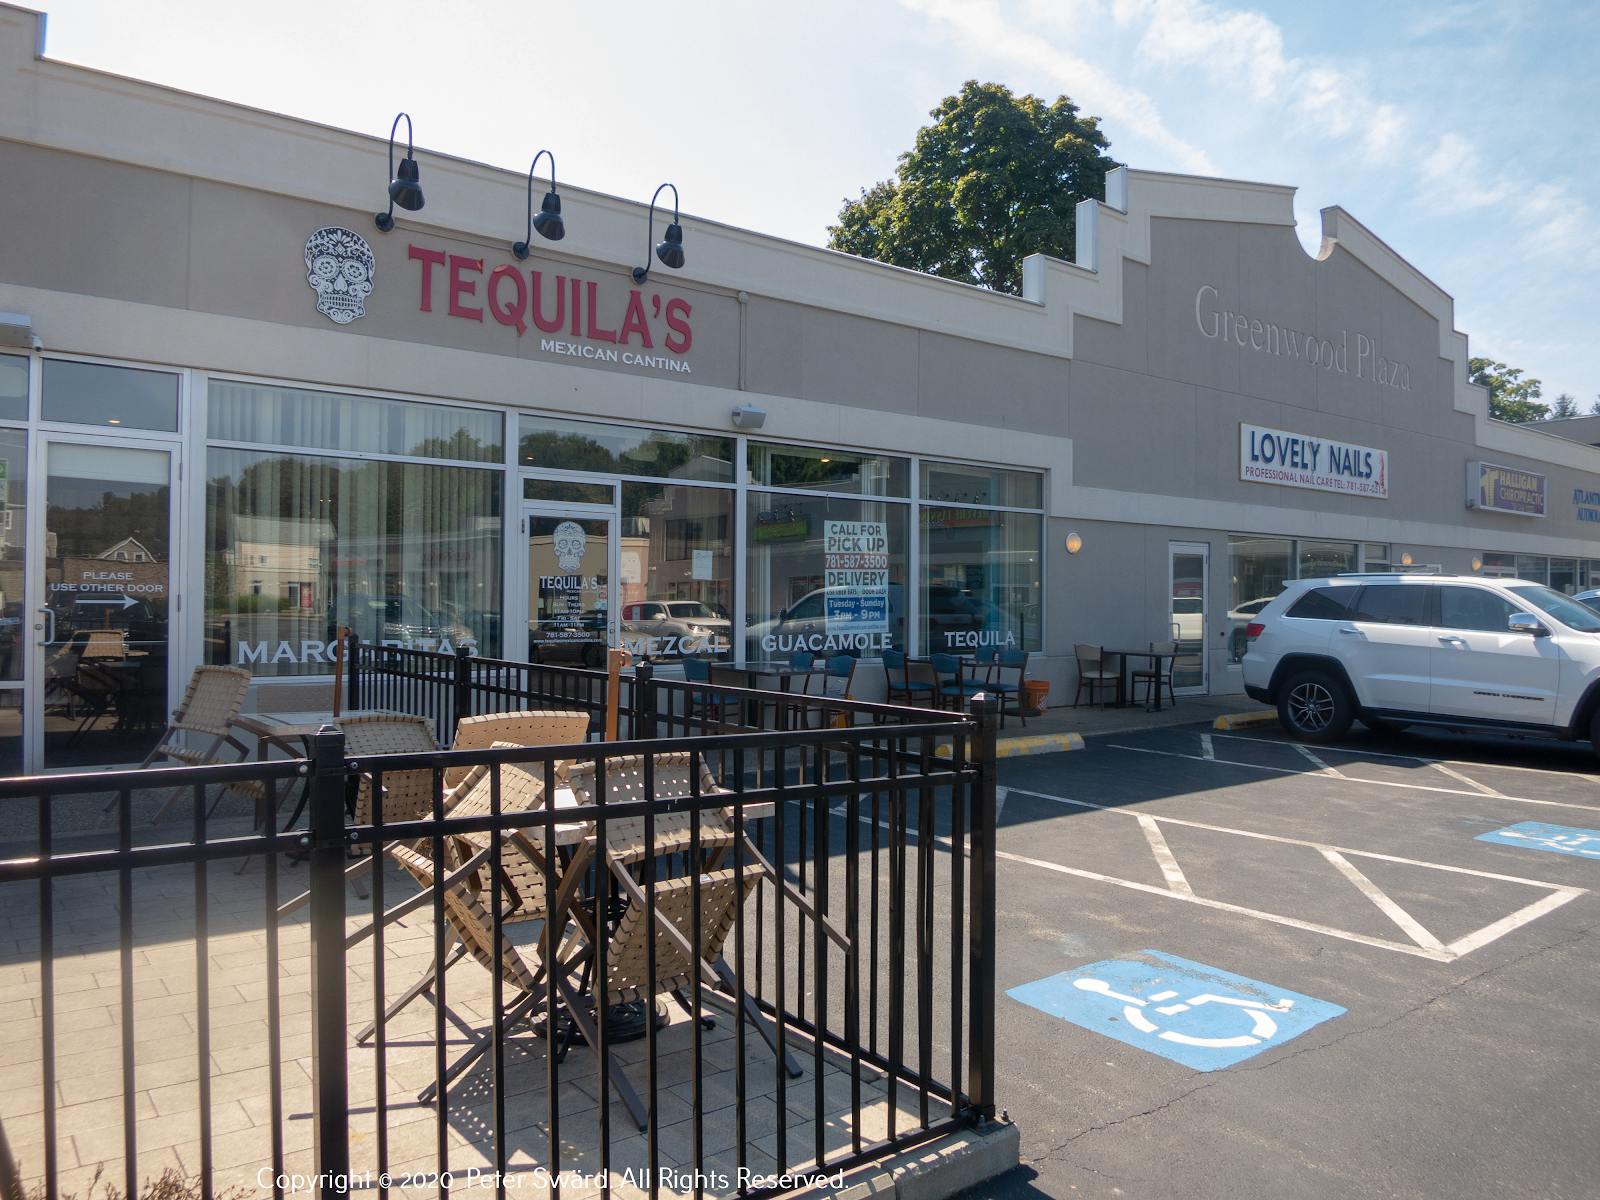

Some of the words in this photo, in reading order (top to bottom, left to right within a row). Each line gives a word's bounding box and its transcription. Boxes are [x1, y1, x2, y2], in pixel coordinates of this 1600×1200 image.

[408, 243, 693, 354] TEQUILA'S
[1195, 284, 1349, 373] Greenwood
[1356, 331, 1412, 391] Plaza
[540, 338, 618, 363] MEXICAN
[622, 352, 692, 374] CANTINA
[1250, 430, 1321, 472] LOVELY
[1328, 445, 1373, 479] NAILS
[1245, 466, 1298, 482] PROFESSIONAL
[1299, 473, 1315, 485] NAIL
[1316, 476, 1333, 488] CARE
[1333, 479, 1346, 490] TEL:
[1500, 470, 1538, 492] HALLIGAN
[1500, 487, 1544, 506] CHIROPRACTIC
[831, 524, 858, 536] CALL
[860, 525, 881, 536] FOR
[828, 536, 862, 552] PICK
[866, 538, 885, 552] UP
[825, 554, 887, 569] 781-587-3500
[83, 571, 134, 581] PLEASE
[540, 576, 598, 590] TEQUILA'S
[828, 571, 886, 587] DELIVERY
[51, 583, 77, 592] USE
[80, 583, 124, 592] OTHER
[127, 584, 164, 593] DOOR
[829, 600, 855, 609] Tuesday
[860, 598, 885, 608] Sunday
[861, 609, 881, 620] 9PM
[624, 635, 728, 656] MEZCAL
[761, 632, 893, 652] GUACAMOLE
[944, 630, 1016, 648] TEQUILA
